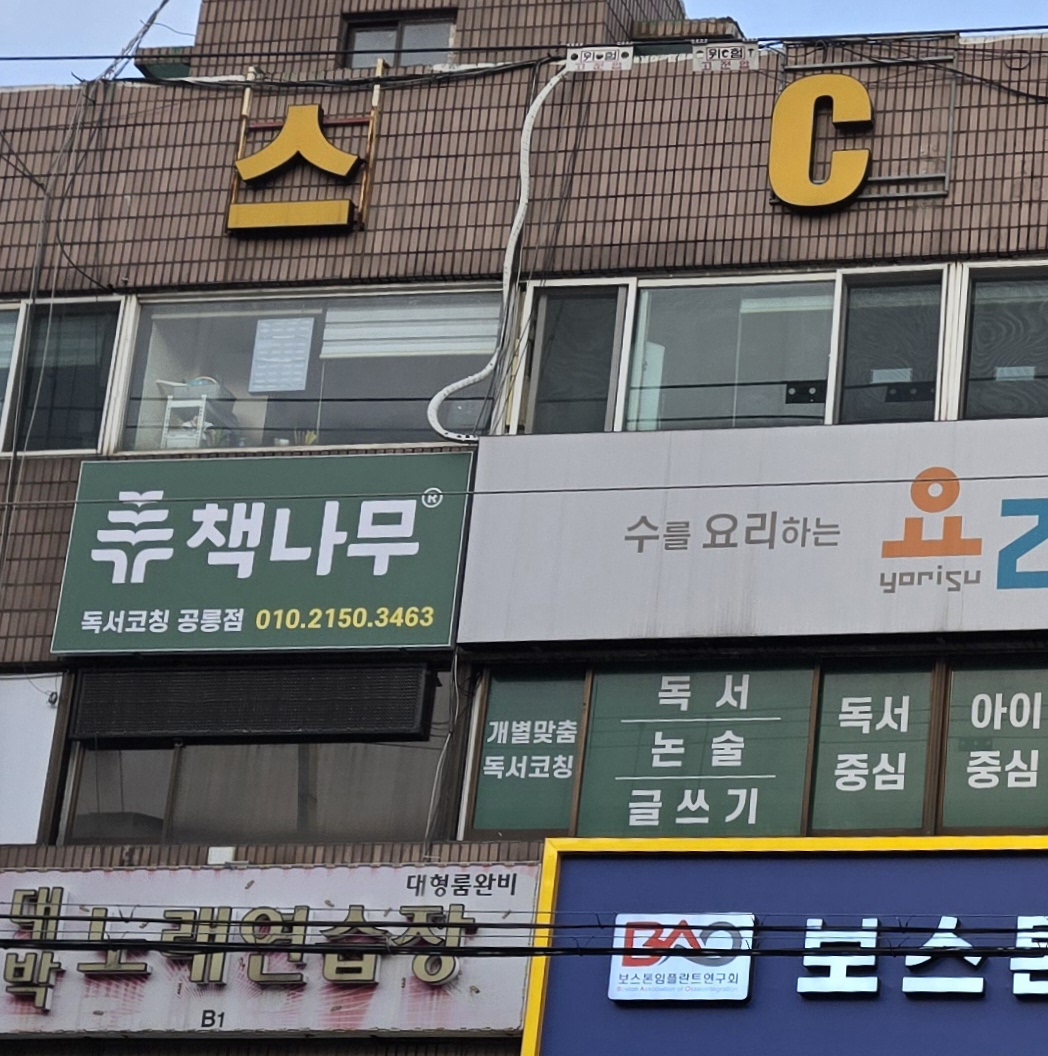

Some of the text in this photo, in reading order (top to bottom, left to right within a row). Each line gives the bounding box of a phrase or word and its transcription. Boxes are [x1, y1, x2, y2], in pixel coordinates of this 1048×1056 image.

[187, 500, 419, 579] 책나무
[624, 511, 841, 553] 수를 요리하는
[880, 567, 982, 594] yorisu
[81, 606, 435, 634] 독서코칭 공릉점 010.2150.3463
[658, 674, 750, 711] 독서
[970, 692, 1043, 730] 아이
[486, 720, 578, 745] 개별맞춤
[838, 695, 911, 734] 독서
[483, 754, 574, 779] 독서코칭
[651, 730, 745, 768] 논술
[834, 752, 907, 792] 중심
[966, 749, 1039, 789] 중심
[628, 788, 759, 826] 글쓰기
[406, 873, 518, 897] 대형룸완비
[77, 904, 478, 987] 노래연습장
[621, 919, 743, 967] BAO
[618, 972, 739, 985] 보스톤임플란트연구회
[201, 1009, 226, 1029] B1
